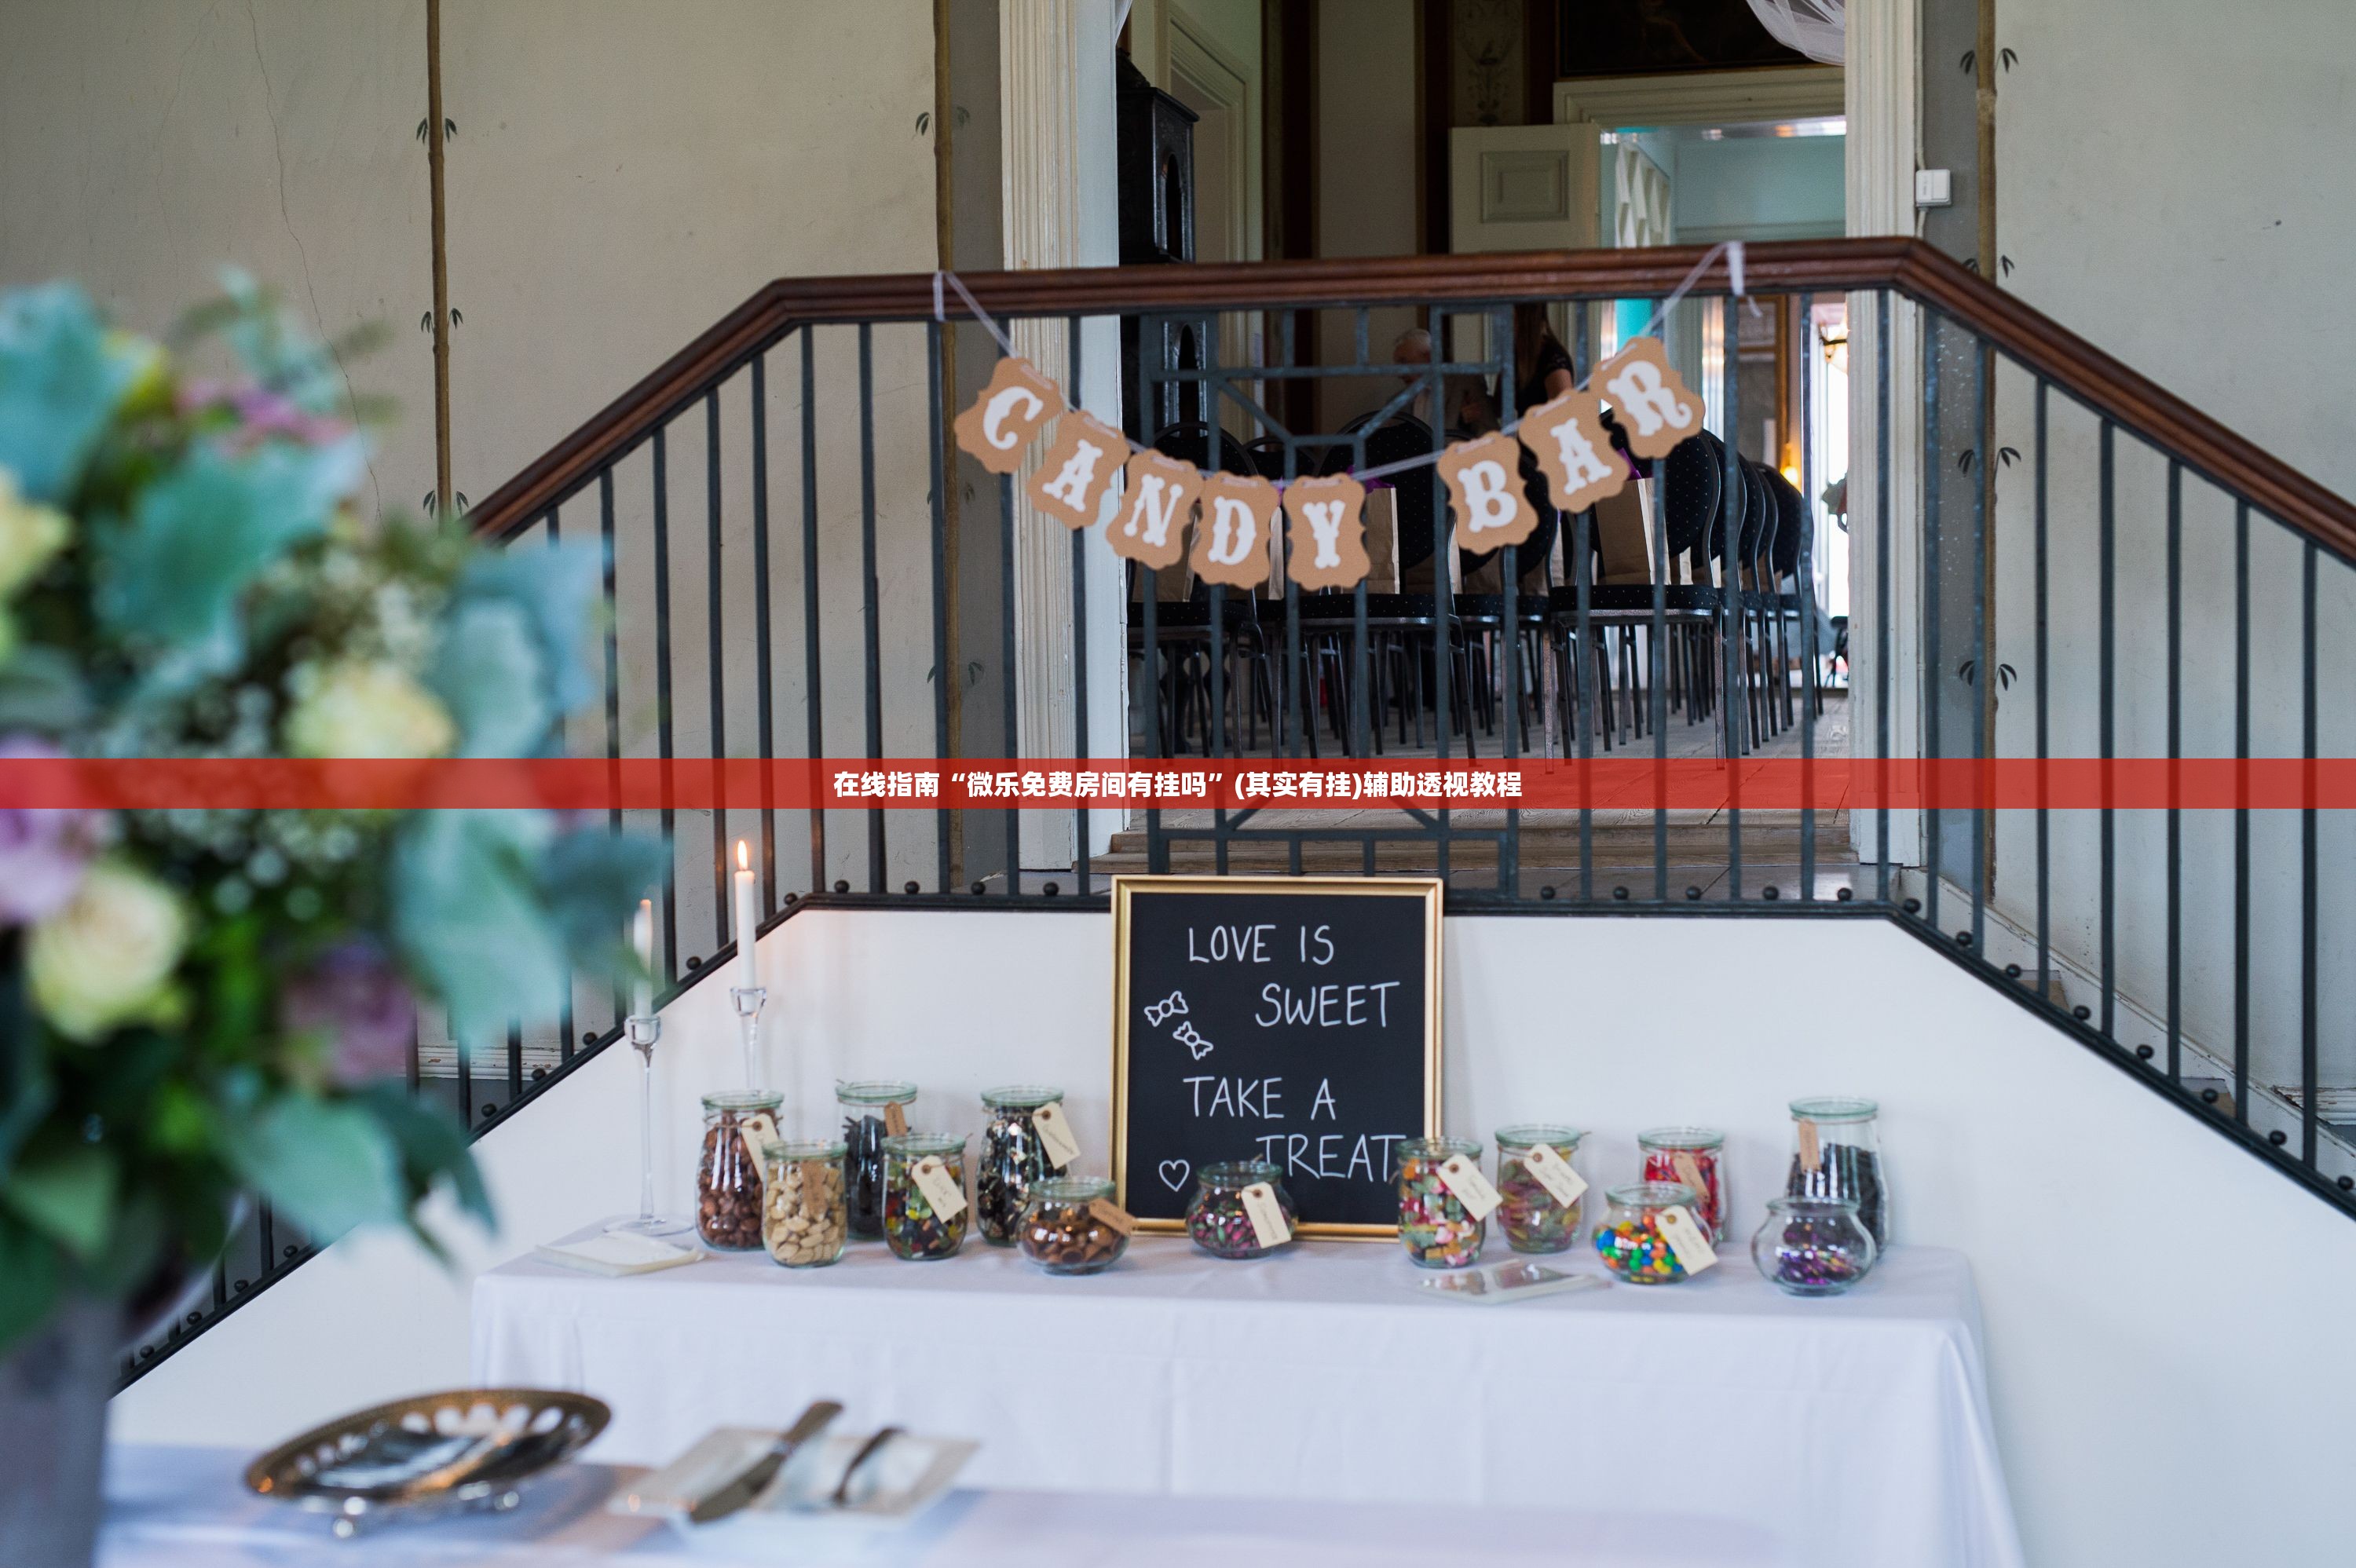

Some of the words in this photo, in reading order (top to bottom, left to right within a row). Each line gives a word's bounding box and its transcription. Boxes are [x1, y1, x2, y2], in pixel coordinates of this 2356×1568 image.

[982, 386, 1346, 570] CANDY
[1456, 360, 1693, 533] BAR
[1188, 924, 1277, 963] LOVE
[1300, 925, 1335, 966] IS
[1255, 981, 1400, 1028] SWEET
[1183, 1076, 1285, 1118] TAKE
[1310, 1078, 1337, 1120] A
[1256, 1133, 1407, 1182] TREAT
